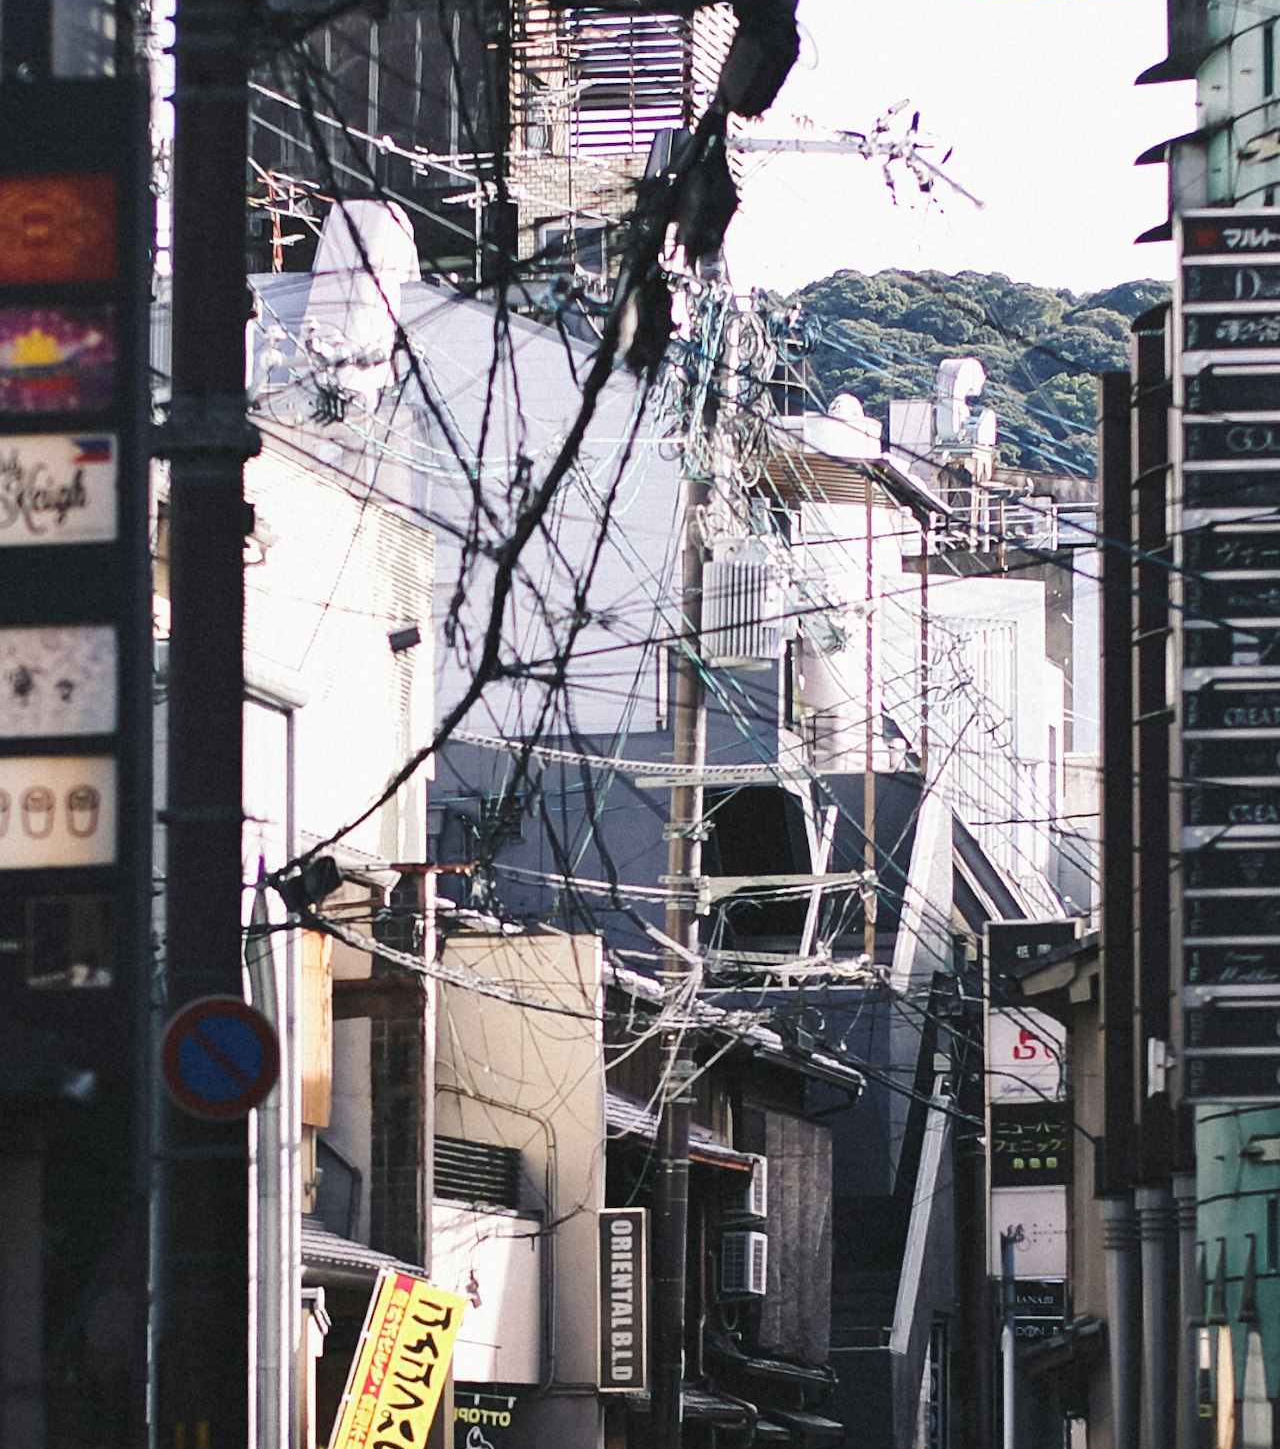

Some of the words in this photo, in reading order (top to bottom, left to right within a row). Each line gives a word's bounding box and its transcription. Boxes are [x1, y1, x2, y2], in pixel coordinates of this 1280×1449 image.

[996, 1120, 1065, 1135] ニューハー
[993, 1138, 1067, 1153] フェニック
[611, 1219, 634, 1328] ORIENTAL
